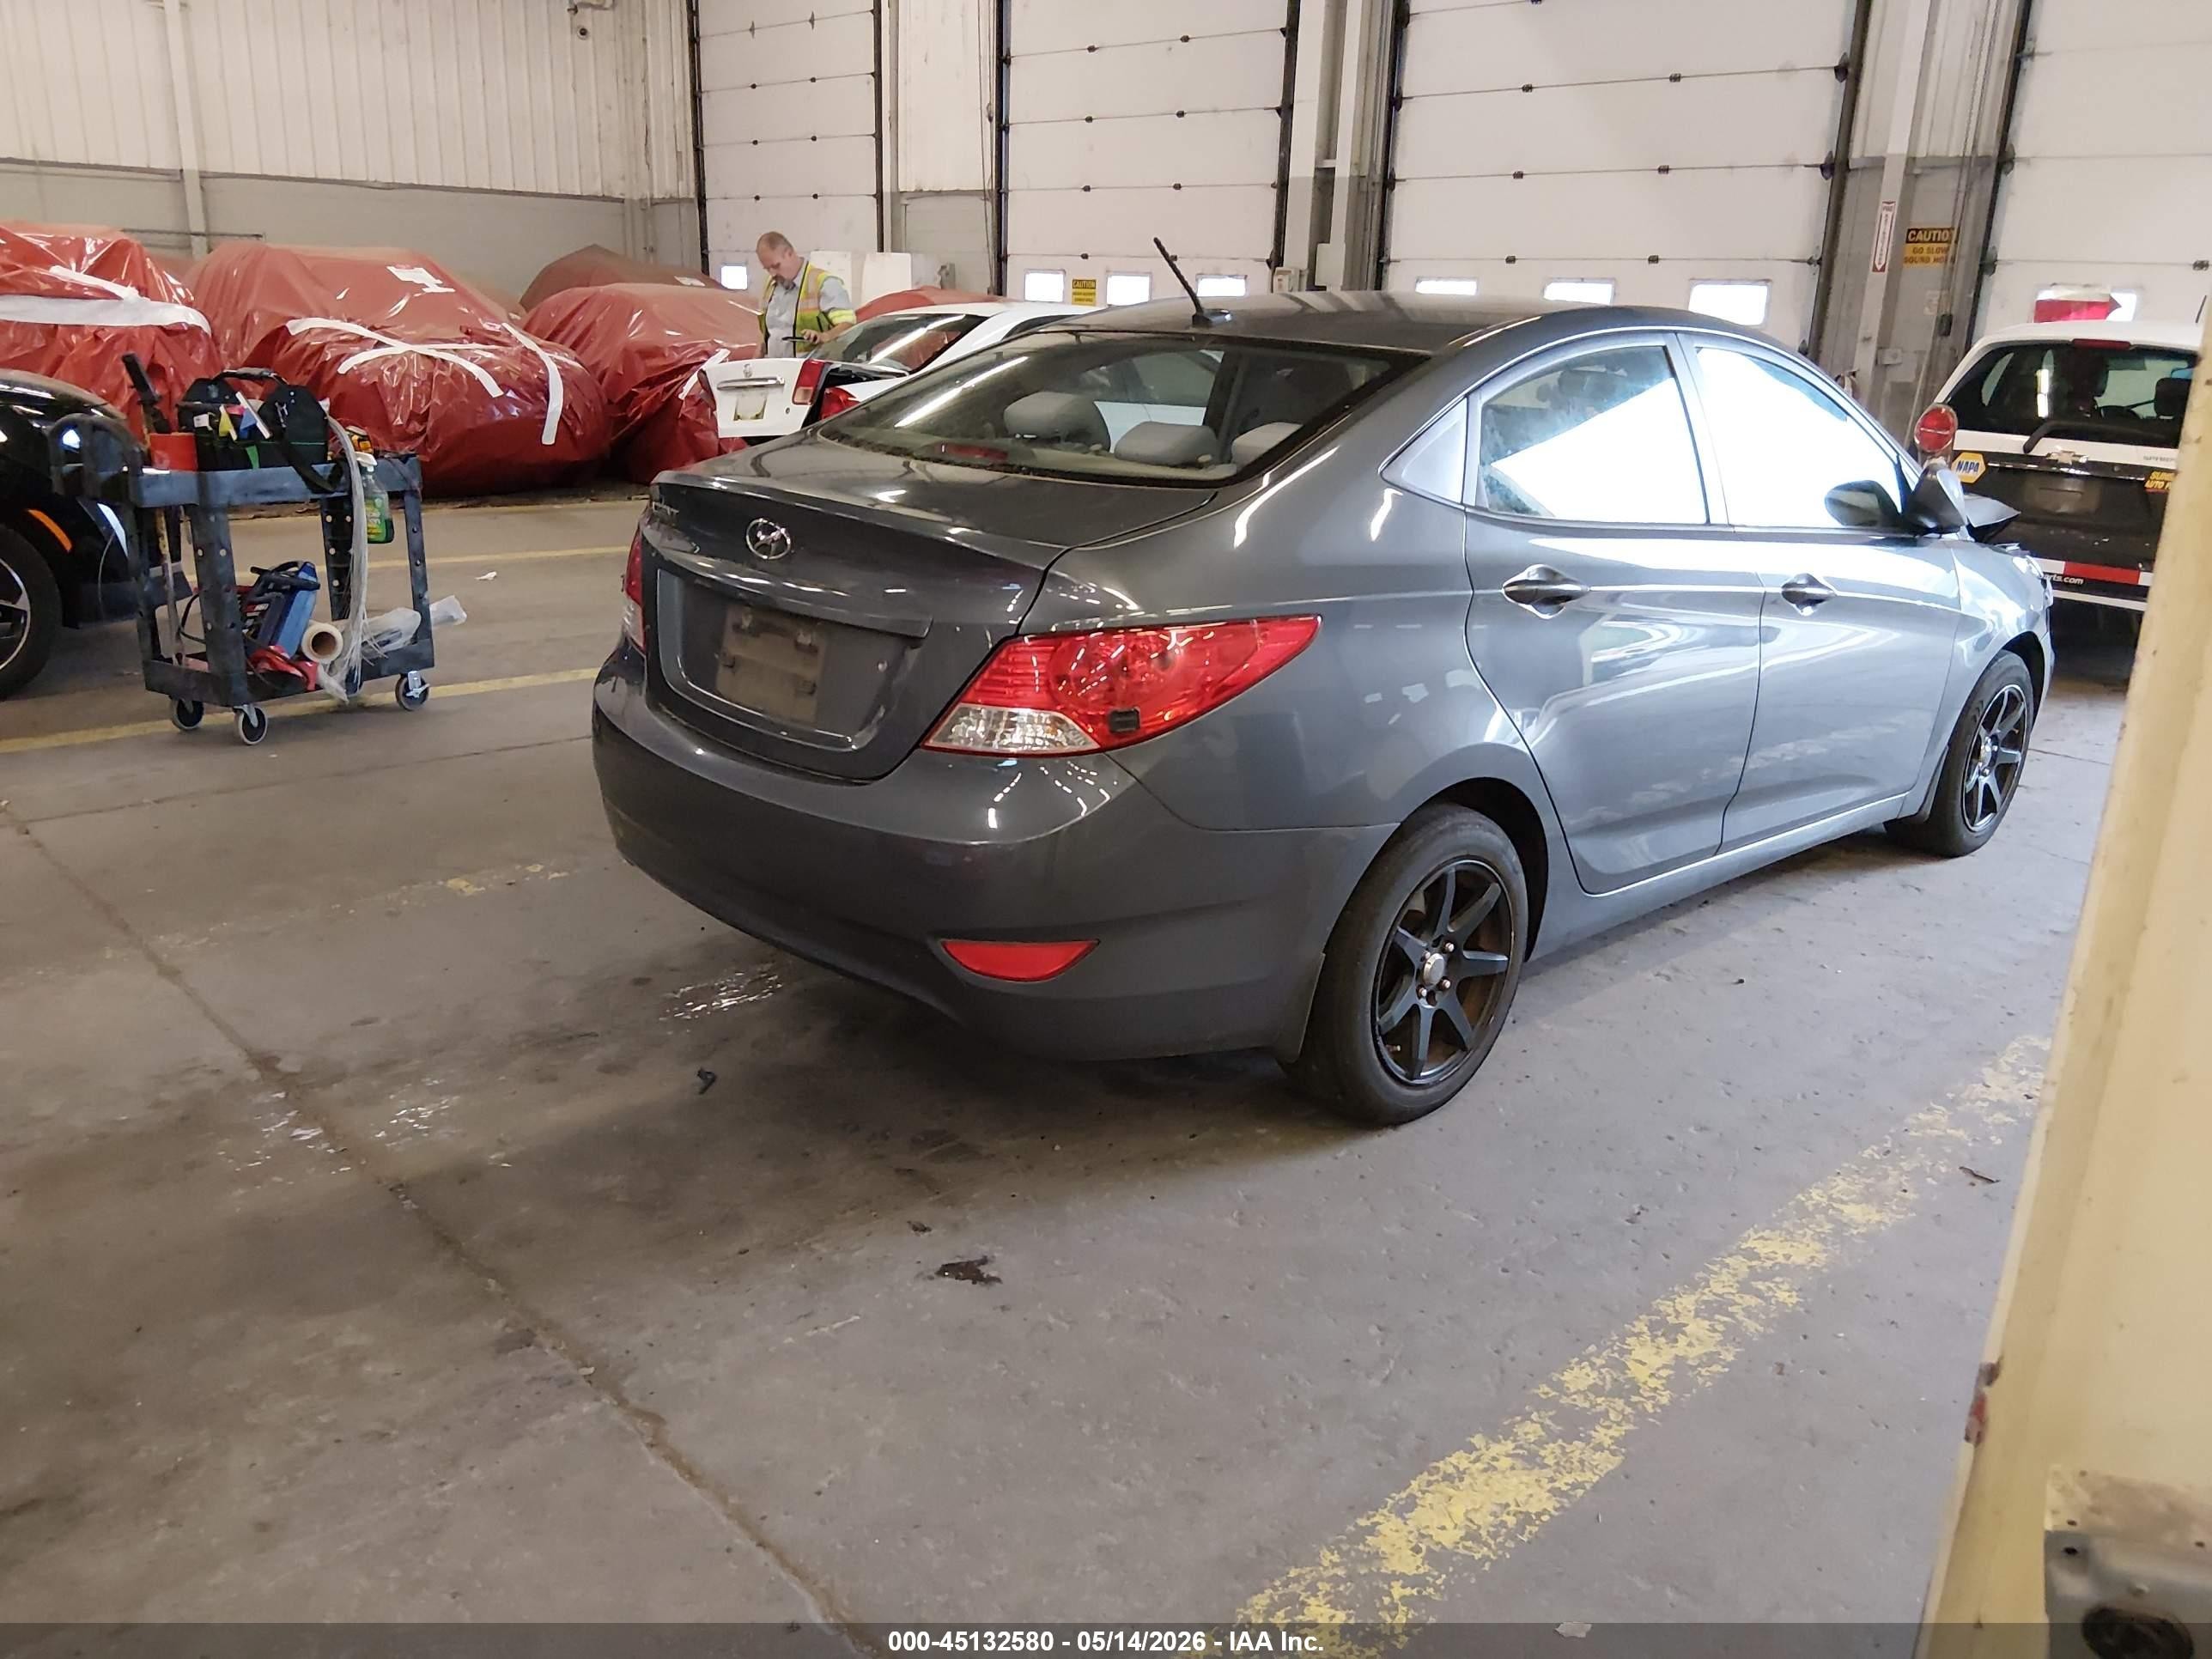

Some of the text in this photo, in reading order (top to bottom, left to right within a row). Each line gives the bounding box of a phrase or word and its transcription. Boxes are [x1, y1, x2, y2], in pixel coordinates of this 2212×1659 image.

[1908, 229, 1950, 241] CAUTIO
[1956, 459, 1980, 473] NAPA
[2144, 480, 2165, 489] AUTO
